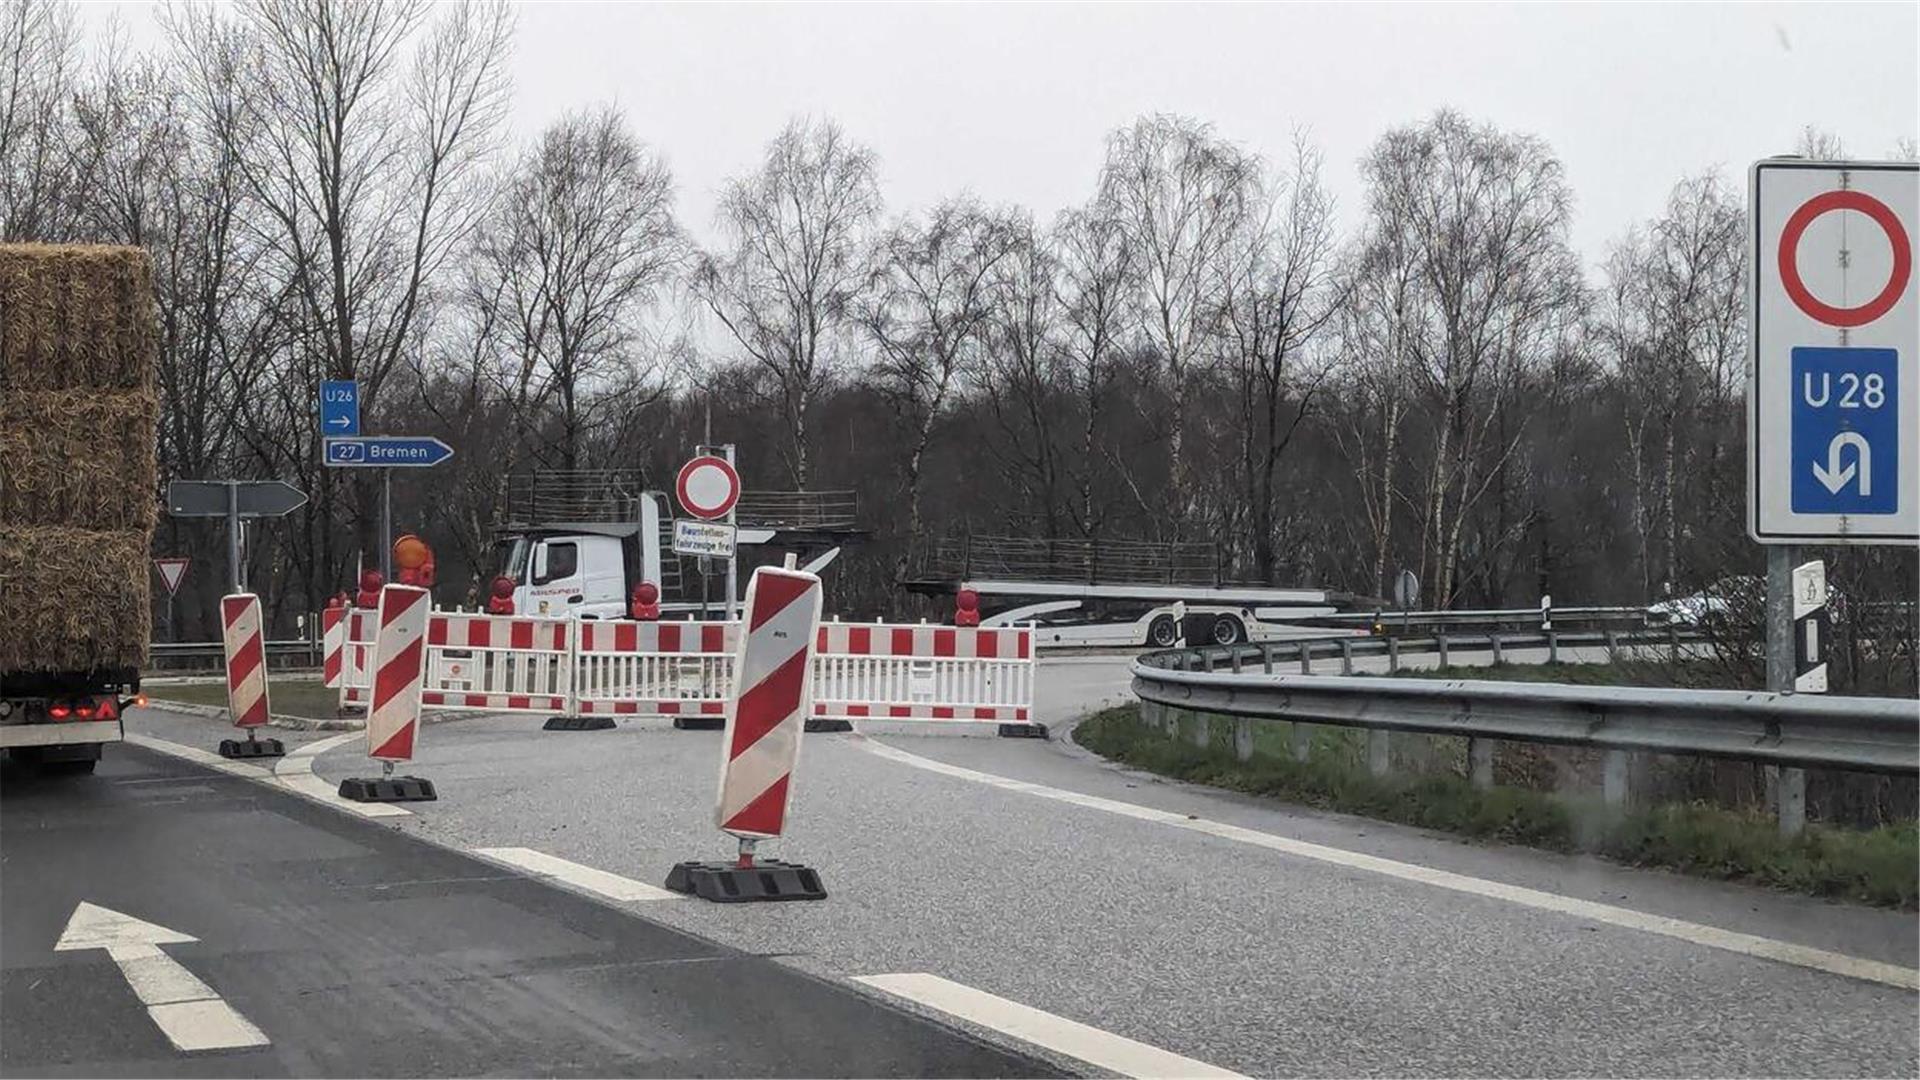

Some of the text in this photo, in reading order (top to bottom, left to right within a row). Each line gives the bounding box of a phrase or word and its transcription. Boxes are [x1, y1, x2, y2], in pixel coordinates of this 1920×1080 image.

[325, 390, 353, 402] U 26
[1804, 372, 1885, 409] U 28
[339, 445, 428, 458] 27 Bremen
